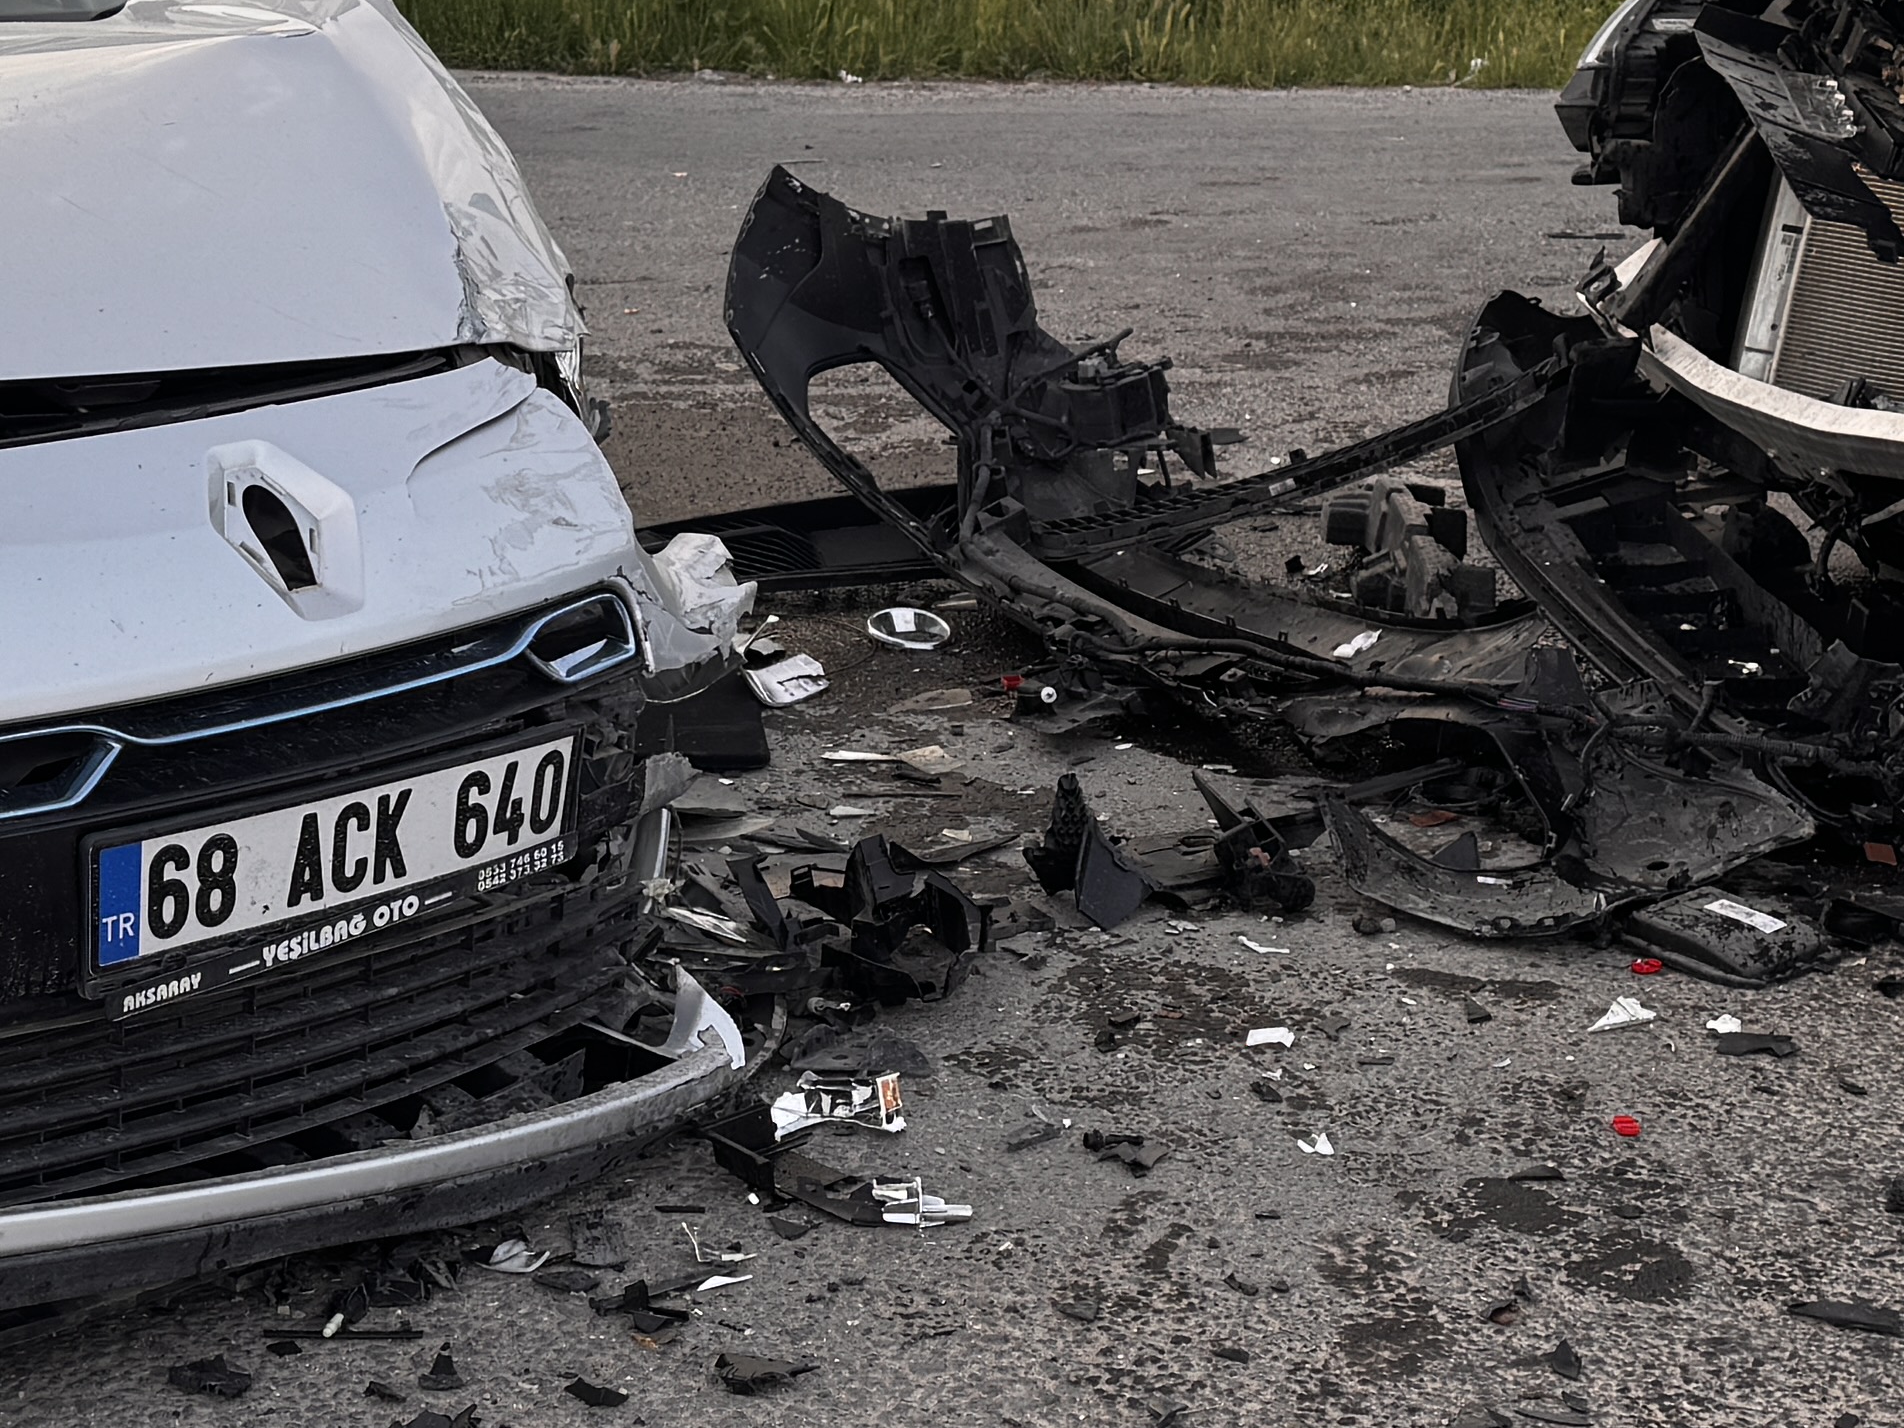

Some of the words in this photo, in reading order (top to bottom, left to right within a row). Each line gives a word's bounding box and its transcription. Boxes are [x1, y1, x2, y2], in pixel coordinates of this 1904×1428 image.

[147, 833, 239, 939] 68
[287, 788, 413, 908] ACK
[454, 749, 566, 860] 640
[510, 853, 530, 868] 746
[534, 848, 547, 860] 60
[102, 912, 134, 942] TR
[373, 895, 420, 927] OTO
[123, 972, 202, 1012] AKSARAY
